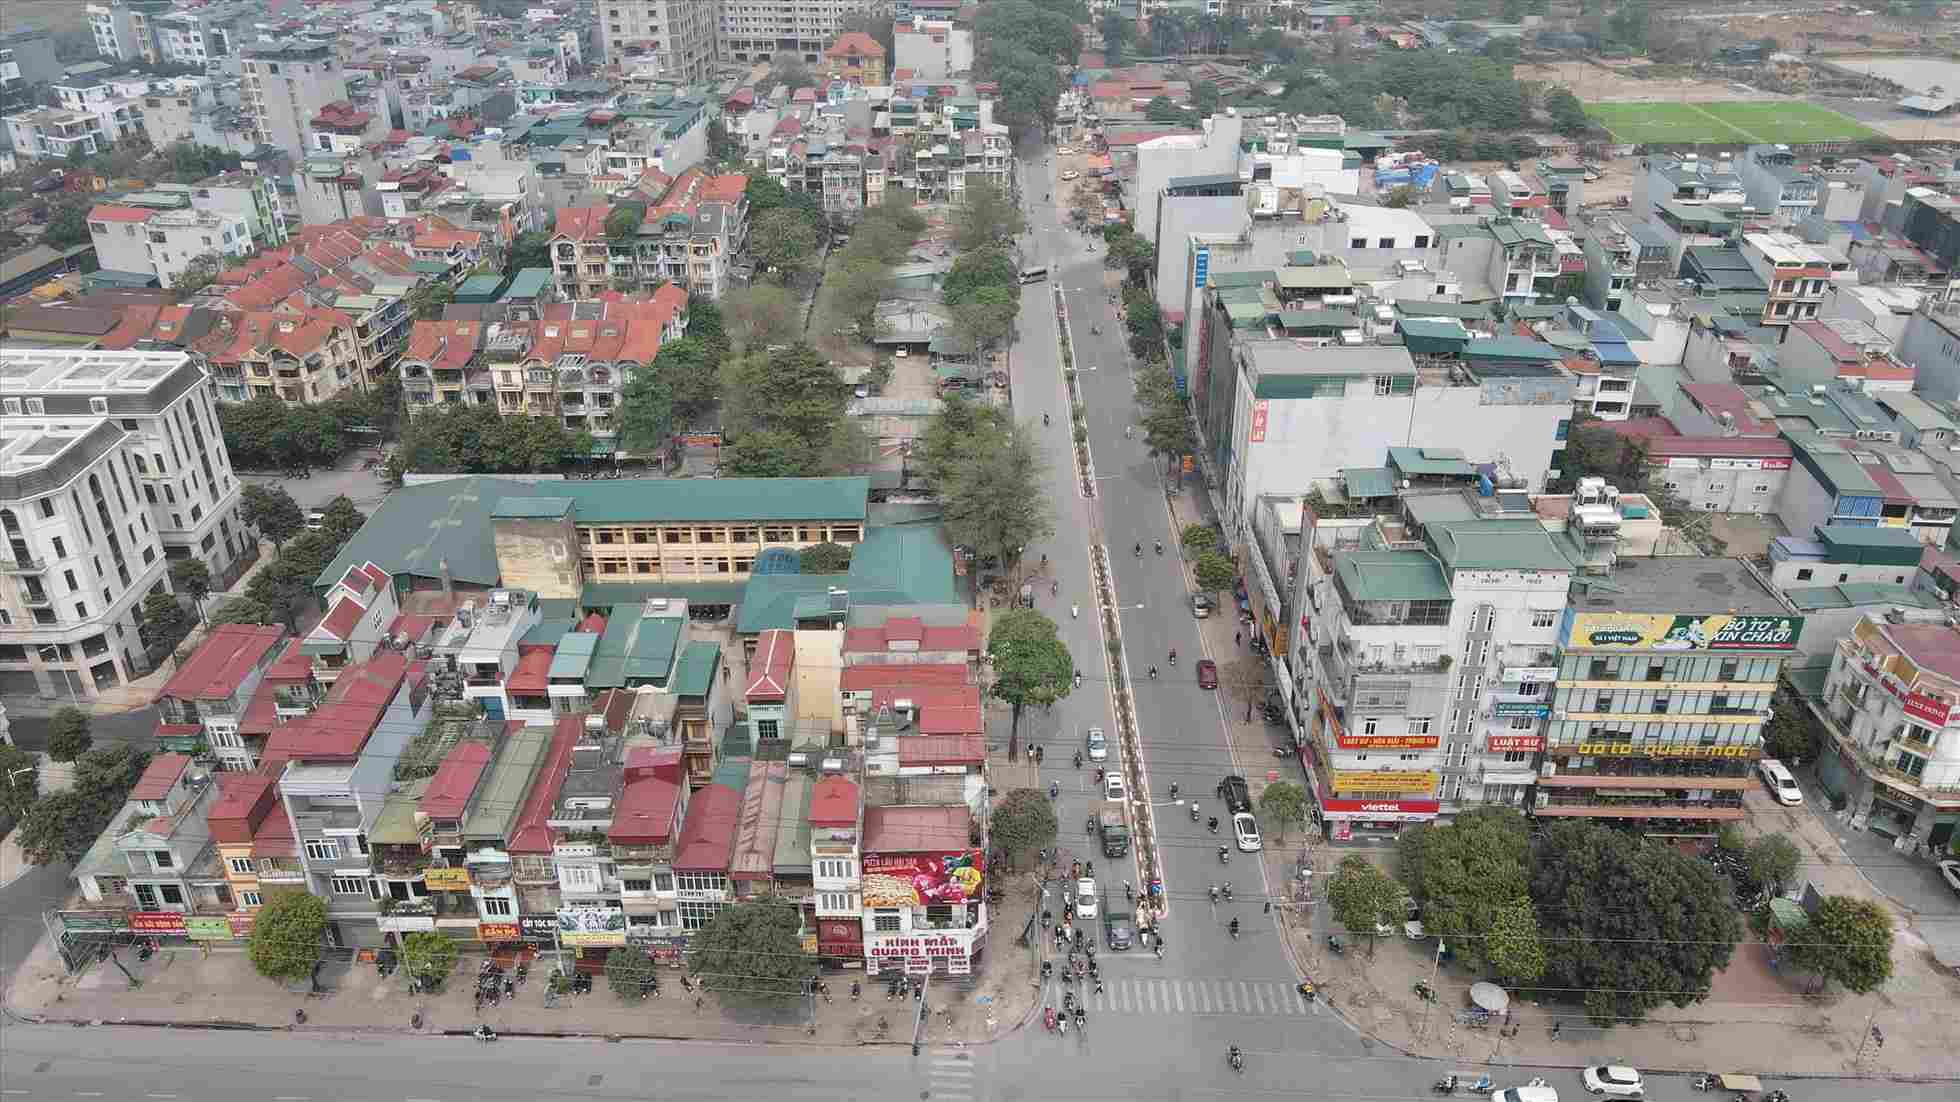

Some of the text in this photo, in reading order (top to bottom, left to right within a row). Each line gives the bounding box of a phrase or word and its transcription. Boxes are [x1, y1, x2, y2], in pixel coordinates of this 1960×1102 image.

[1494, 735, 1521, 746] LUẬT
[1361, 800, 1400, 811] viettel
[885, 935, 957, 947] KÍNH MẮT
[871, 947, 920, 957] QUANG
[926, 946, 965, 956] MINH
